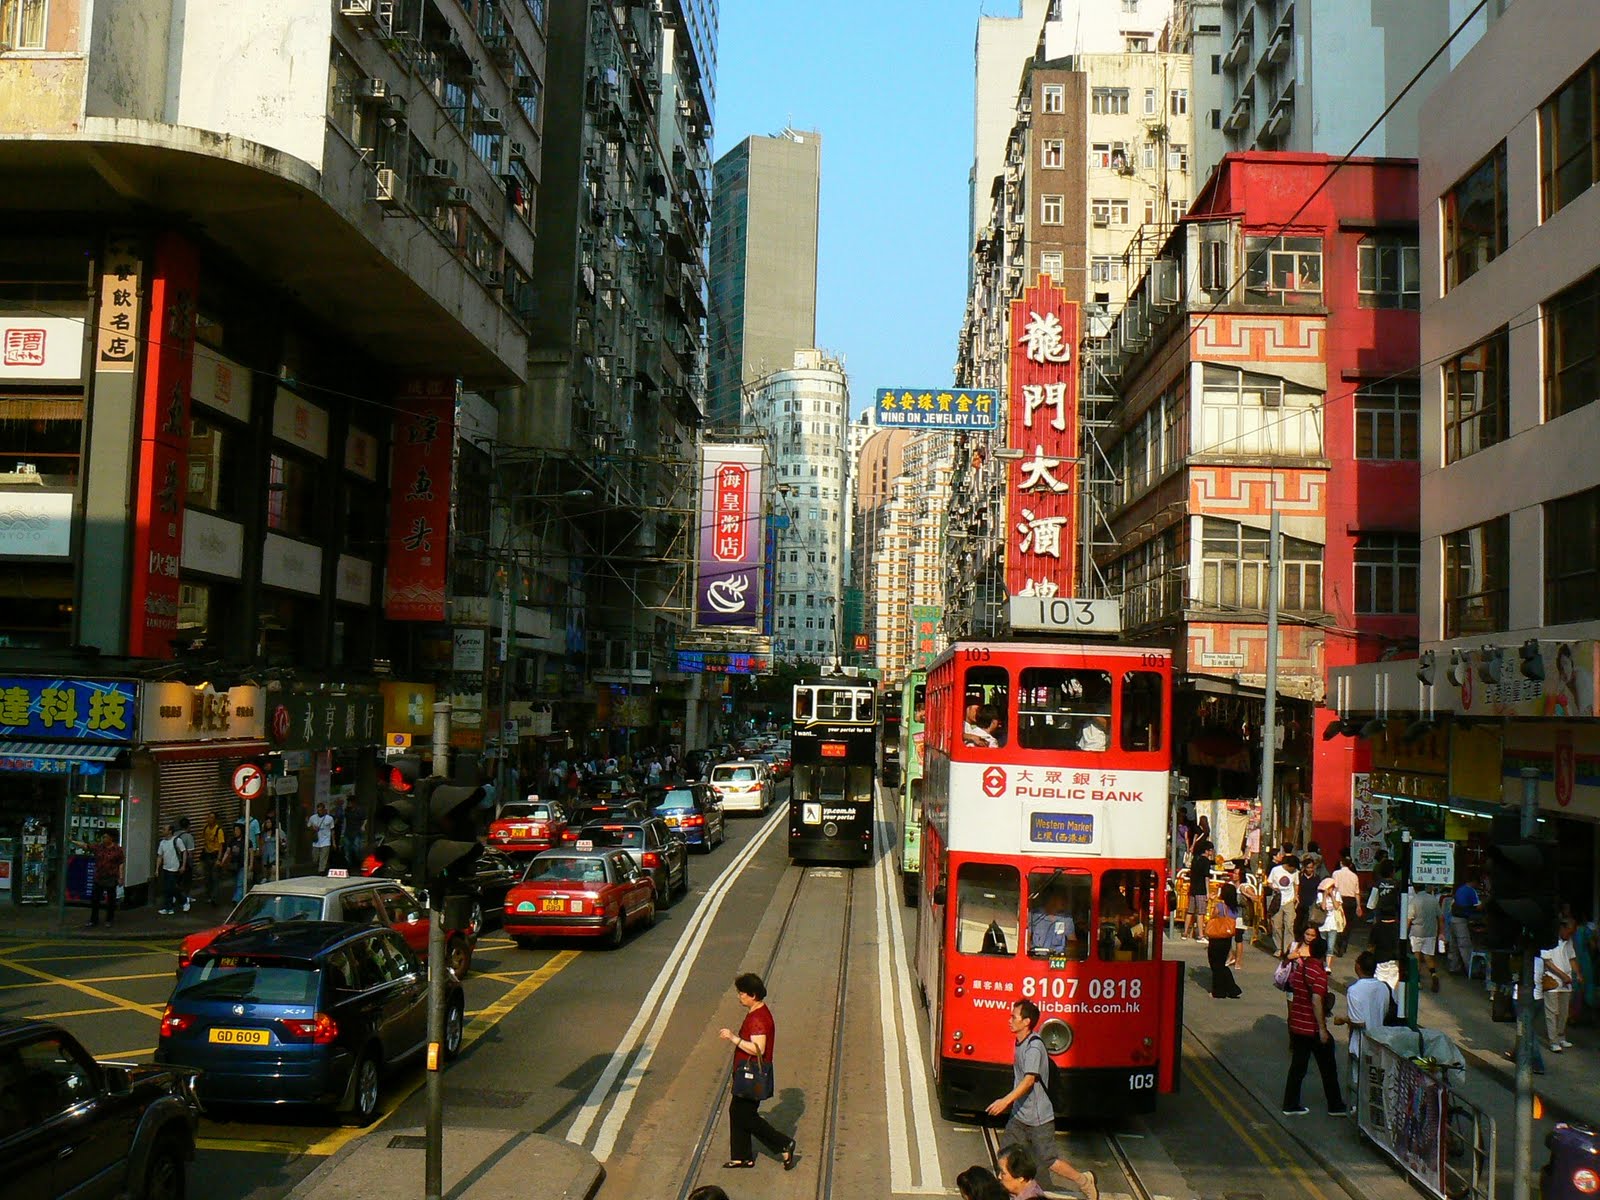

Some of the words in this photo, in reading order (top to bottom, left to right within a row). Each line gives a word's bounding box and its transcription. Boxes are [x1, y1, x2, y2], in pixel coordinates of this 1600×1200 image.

[881, 391, 992, 413] 永安珠寶金行
[881, 411, 904, 423] WING
[908, 412, 921, 423] ON
[923, 413, 968, 425] JEWELRY
[719, 468, 741, 557] 海皇粥店
[1039, 600, 1096, 626] 103
[964, 647, 991, 662] 103
[1141, 653, 1165, 668] 103
[1015, 786, 1086, 800] PUBLIC
[1090, 790, 1144, 803] BANK
[1035, 818, 1065, 830] Western
[1067, 821, 1092, 832] Market
[1436, 867, 1451, 875] STOP
[1022, 976, 1079, 999] 8107
[1088, 979, 1142, 1000] 0818
[973, 998, 1140, 1014] www.licbank.com.hk
[217, 1030, 233, 1042] GD
[236, 1031, 261, 1043] 609
[1129, 1073, 1154, 1090] 103
